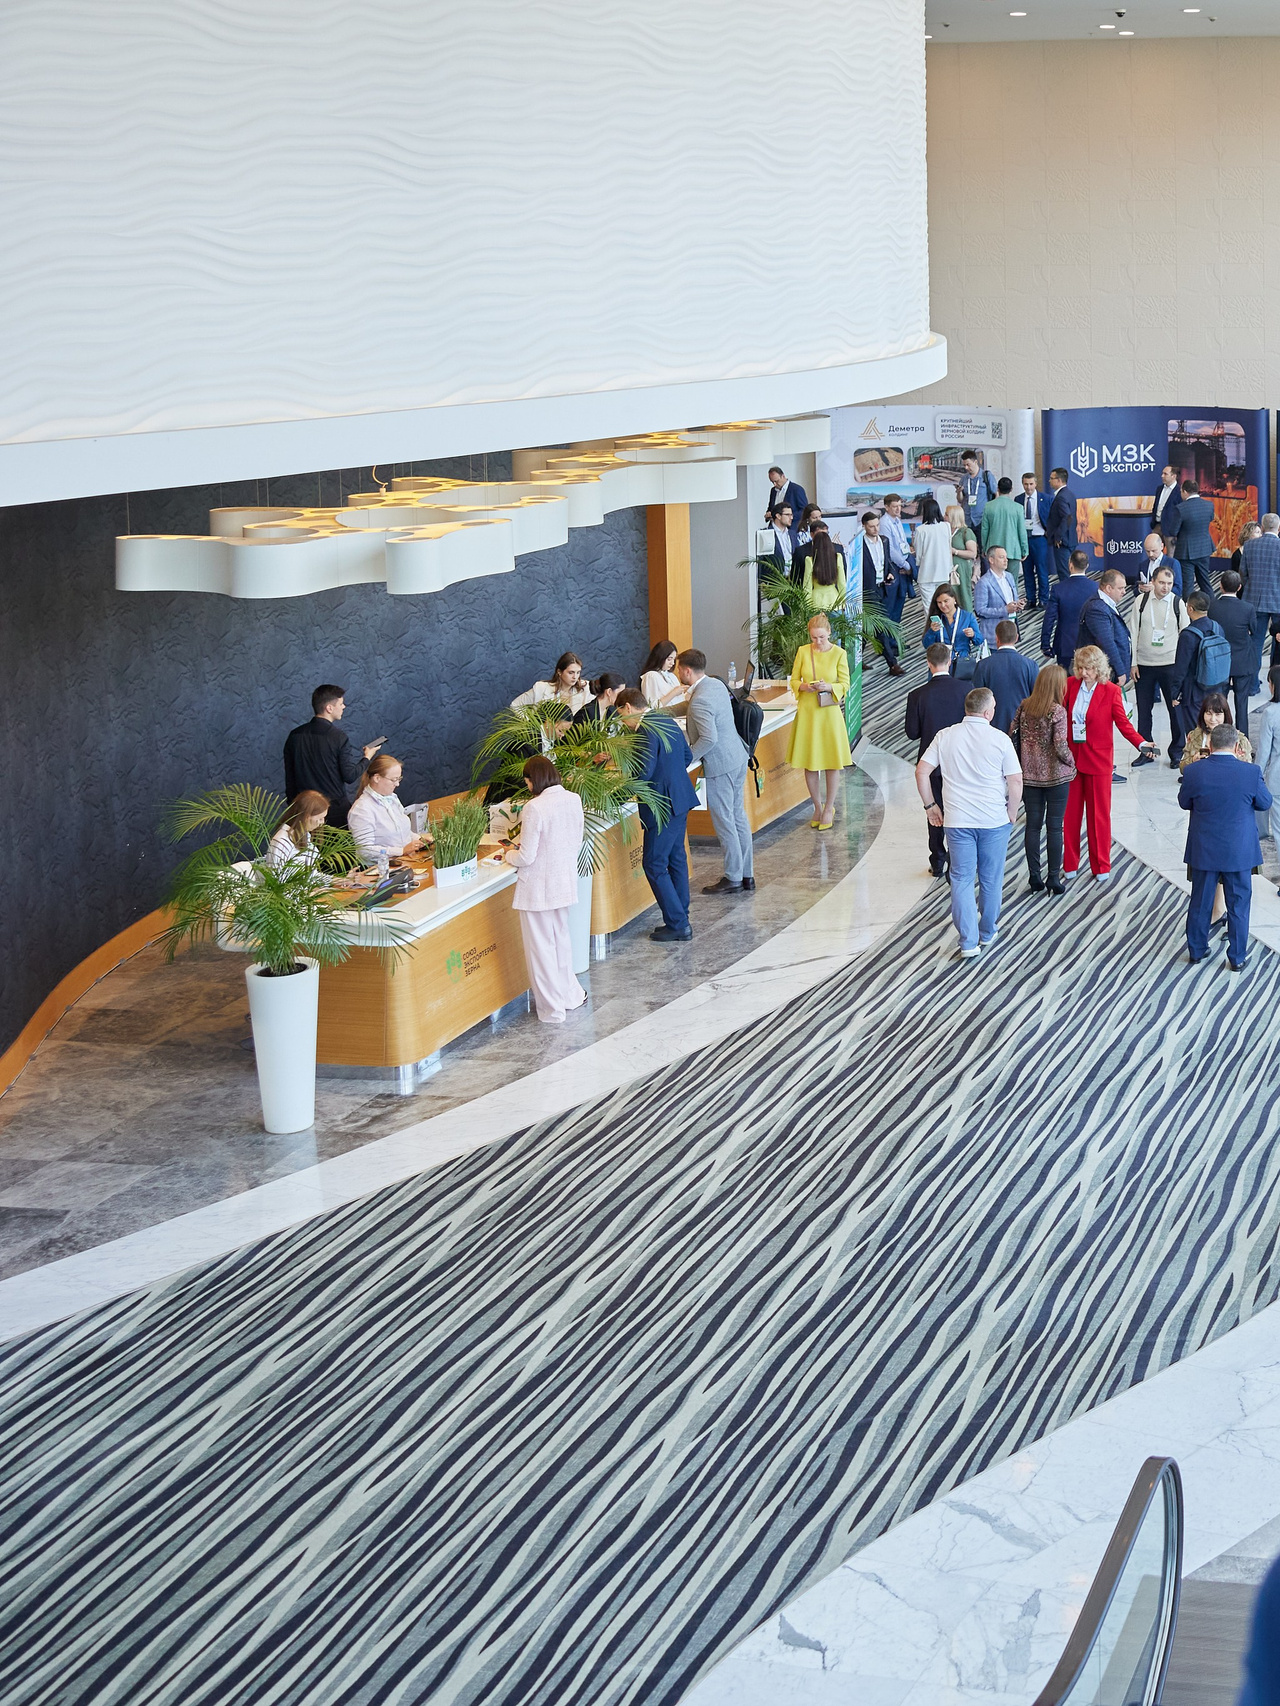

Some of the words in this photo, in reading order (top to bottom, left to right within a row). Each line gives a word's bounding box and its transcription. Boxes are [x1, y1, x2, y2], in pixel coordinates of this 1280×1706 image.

[888, 425, 925, 433] Деметра
[1102, 443, 1155, 463] МЗК
[1103, 463, 1155, 473] ЭКСПОРТ
[1120, 540, 1143, 550] МЗК
[463, 947, 476, 960] СОЮЗ
[464, 943, 496, 969] ЭКСПОРТЕРОВ
[465, 963, 480, 977] ЗЕРНА
